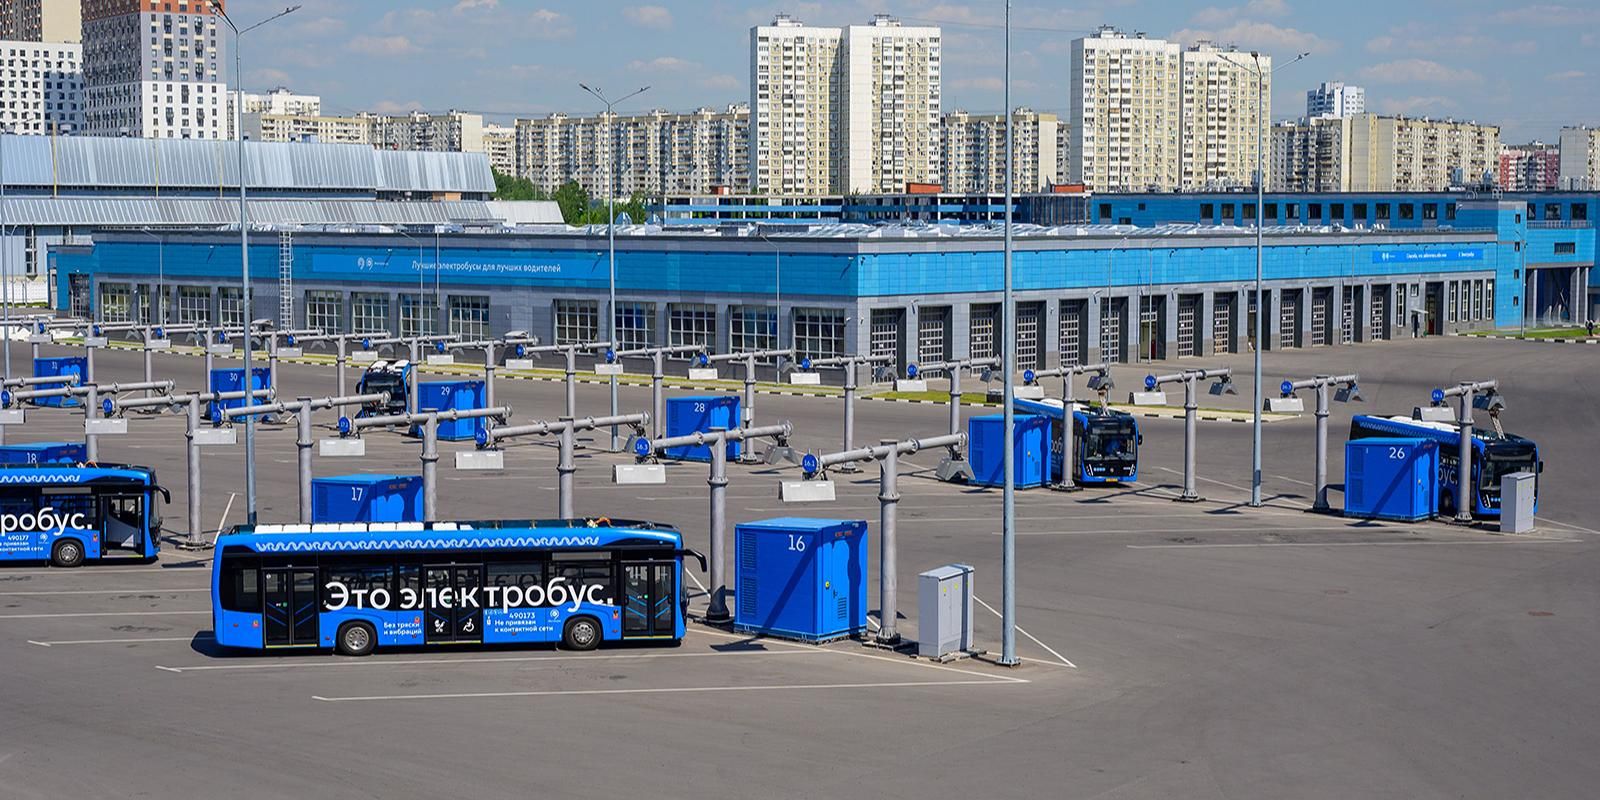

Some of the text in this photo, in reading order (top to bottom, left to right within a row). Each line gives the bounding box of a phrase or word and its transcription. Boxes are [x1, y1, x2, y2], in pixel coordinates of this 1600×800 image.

[523, 263, 561, 273] водителей
[230, 373, 238, 381] 30
[441, 386, 450, 396] 29
[694, 402, 705, 413] 28
[27, 452, 37, 464] 18
[1389, 447, 1405, 460] 26
[804, 459, 815, 467] 16.1
[351, 486, 363, 501] 17
[1, 507, 92, 536] робус.
[788, 534, 806, 551] 16
[325, 581, 390, 610] Это
[400, 577, 614, 613] электробус.
[390, 628, 422, 636] вибраций
